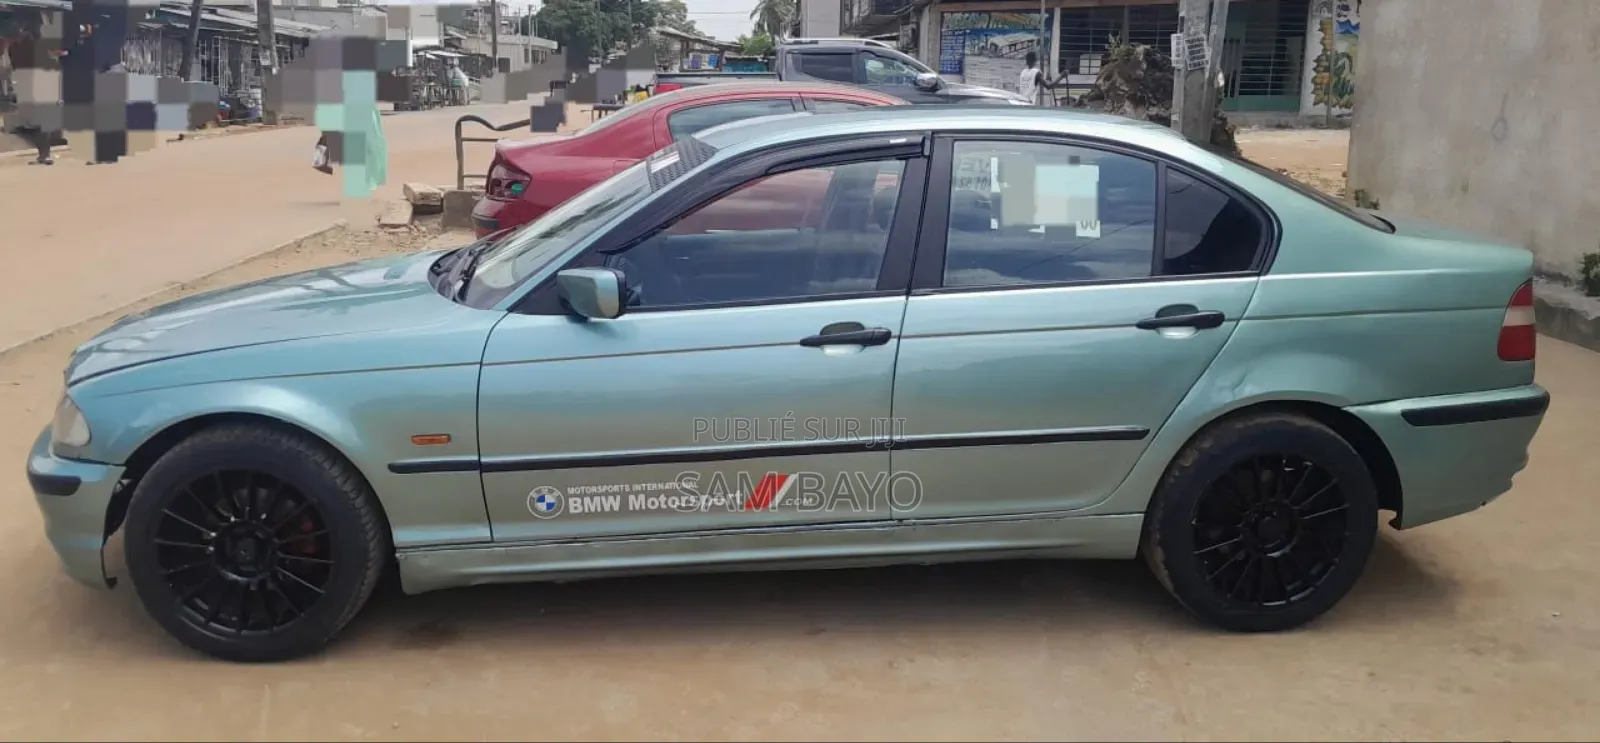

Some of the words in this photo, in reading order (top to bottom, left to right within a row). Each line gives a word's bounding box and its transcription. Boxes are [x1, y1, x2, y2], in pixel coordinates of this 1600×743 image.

[567, 484, 630, 495] MOTORSPORTS
[632, 481, 699, 492] INTERNATIONAL
[568, 495, 621, 514] BMW
[629, 489, 743, 512] Motorsport
